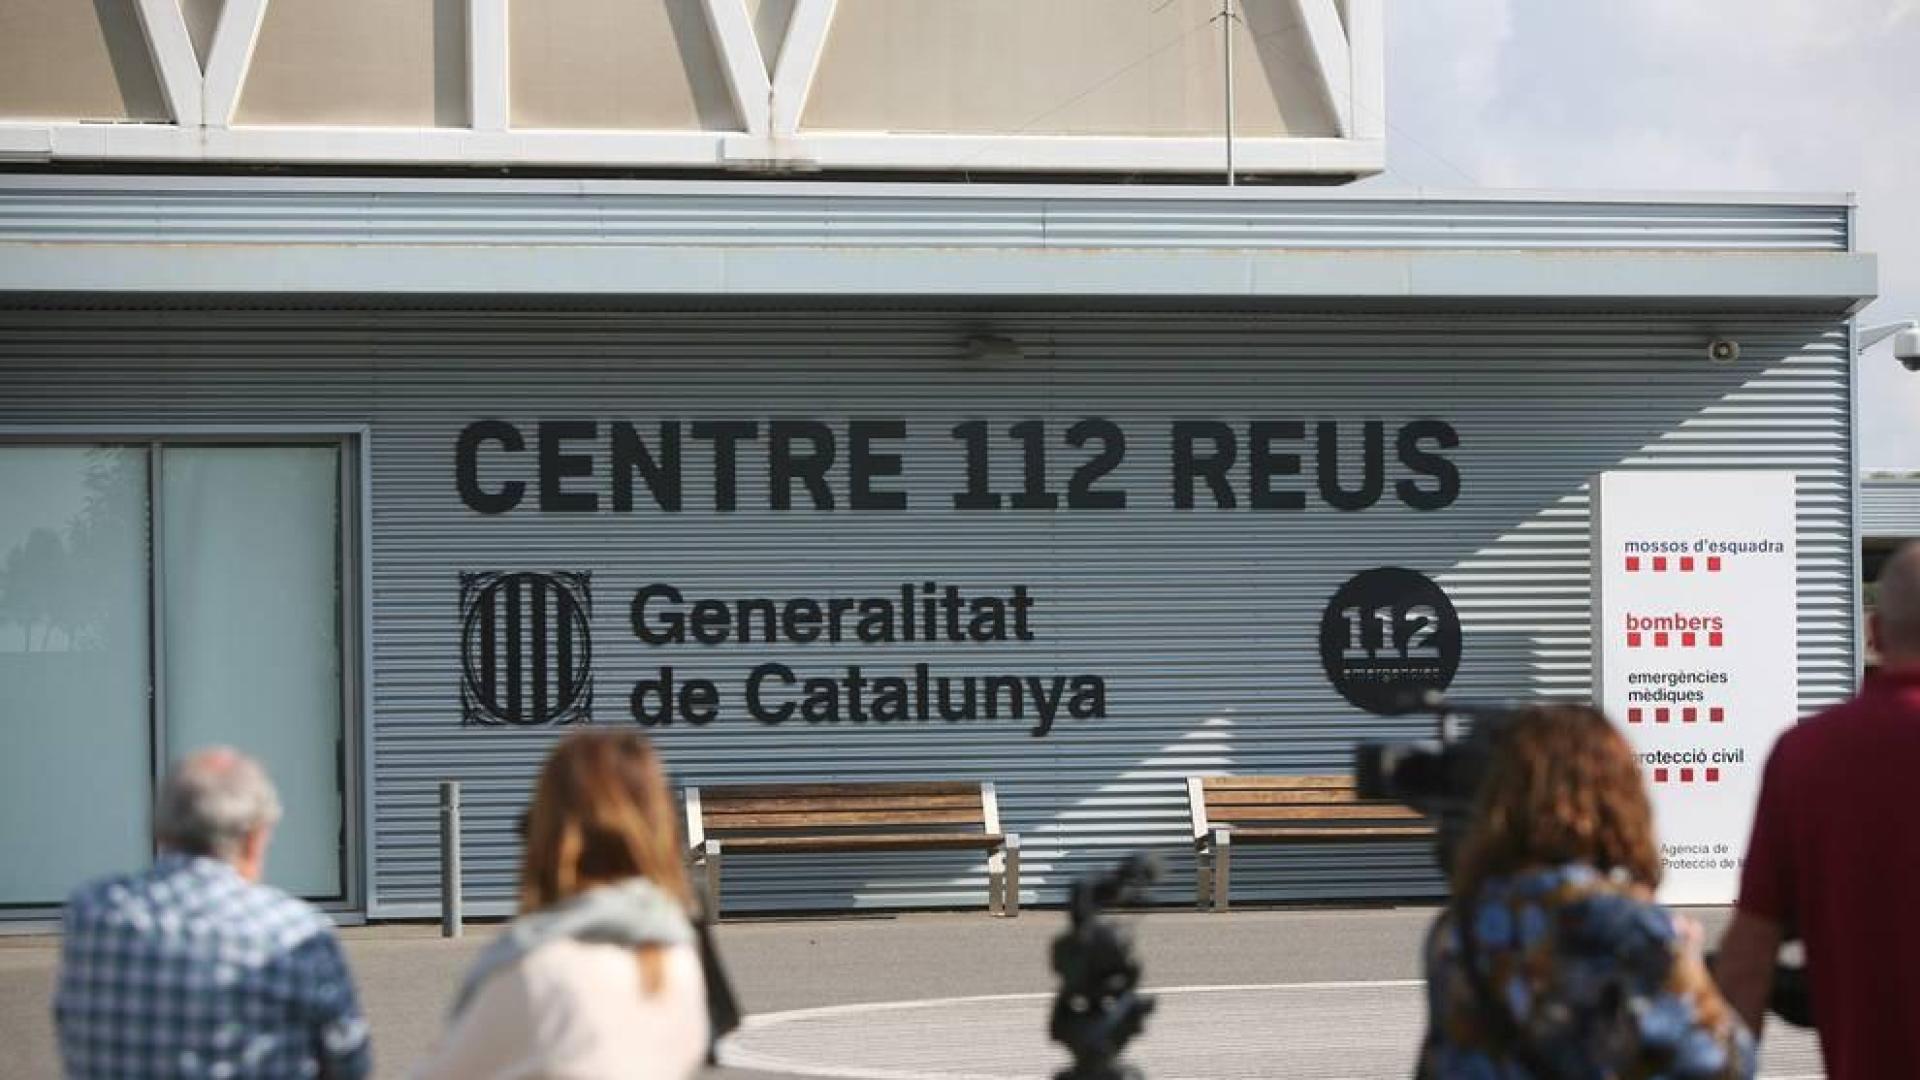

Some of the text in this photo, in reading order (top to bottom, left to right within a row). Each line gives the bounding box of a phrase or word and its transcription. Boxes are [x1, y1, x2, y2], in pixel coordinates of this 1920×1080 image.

[455, 417, 1462, 514] CENTRE 112 REUS
[1624, 538, 1785, 555] mossos d'esquadra
[630, 581, 1035, 646] Generalitat
[1626, 612, 1724, 631] bombers
[1341, 604, 1440, 658] 112
[1628, 668, 1729, 687] emergències
[630, 662, 1107, 738] de Catalunya
[1712, 747, 1744, 763] civil
[1712, 843, 1729, 854] de
